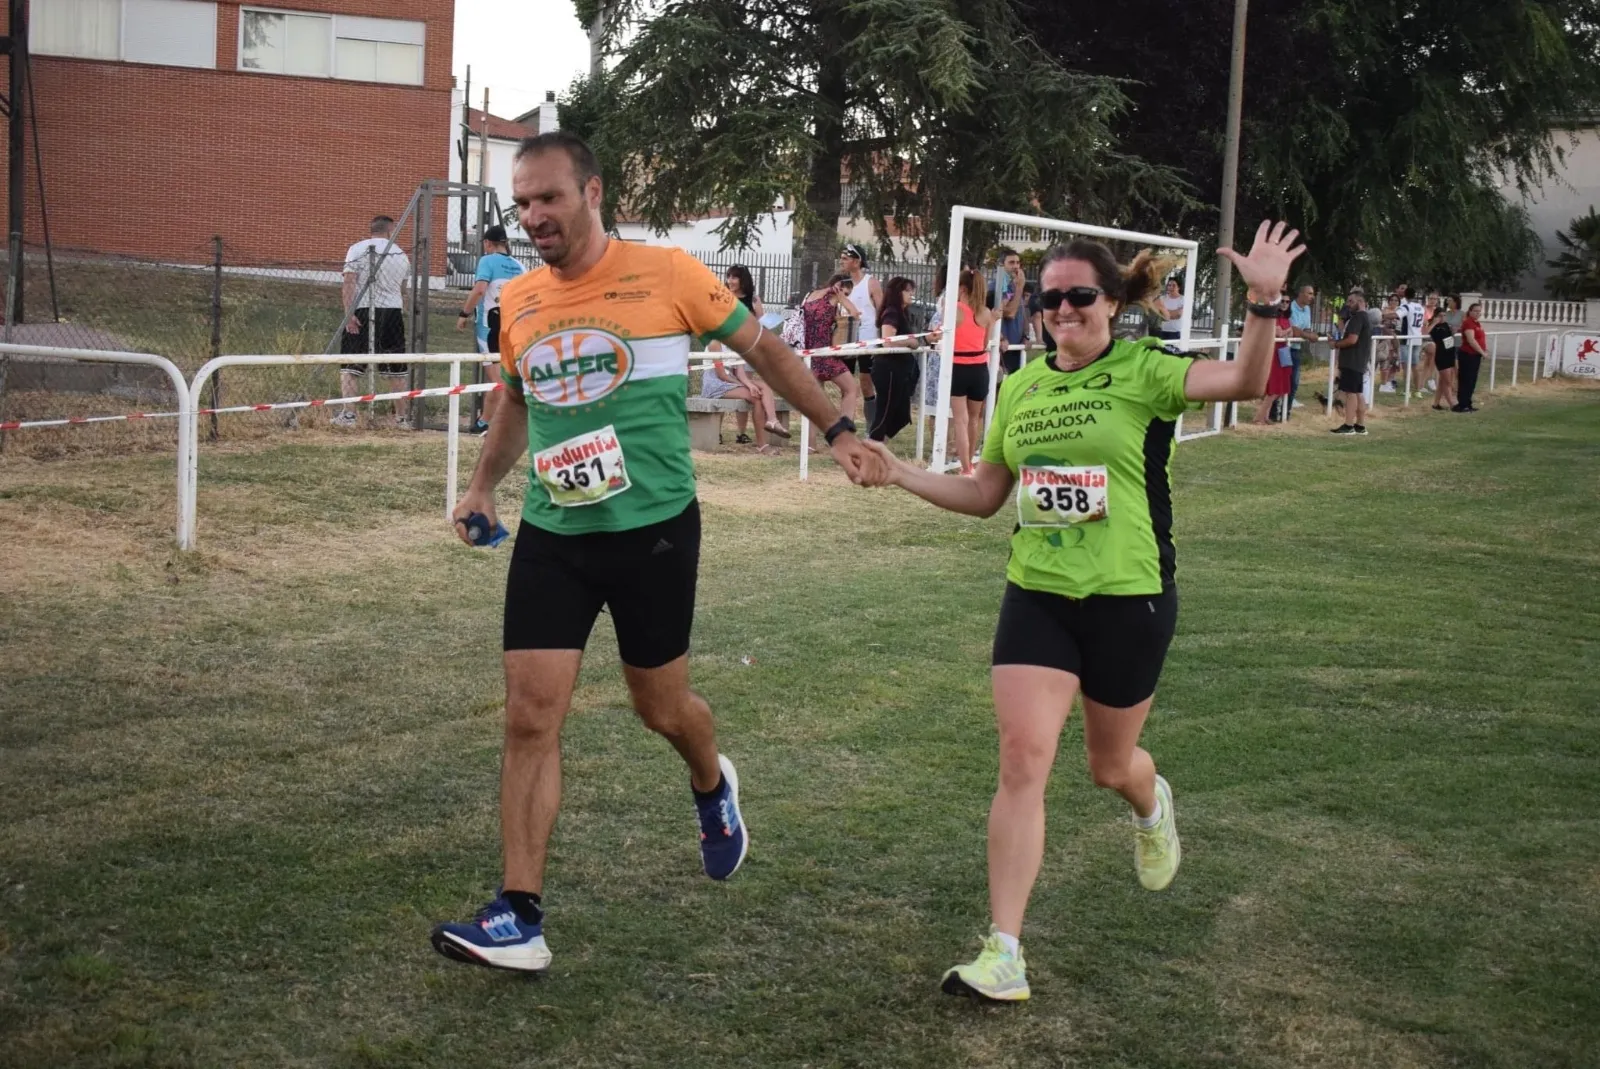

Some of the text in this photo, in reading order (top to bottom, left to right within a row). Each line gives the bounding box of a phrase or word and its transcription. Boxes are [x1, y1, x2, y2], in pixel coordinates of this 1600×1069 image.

[548, 317, 631, 337] DEPORTIVO
[1411, 312, 1424, 328] 12
[530, 352, 619, 383] ALCER
[1572, 366, 1597, 374] LESA
[1007, 413, 1097, 438] CARBAJOSA
[1015, 430, 1084, 448] SALAMANCA
[556, 456, 606, 491] 351
[1035, 486, 1090, 514] 358
